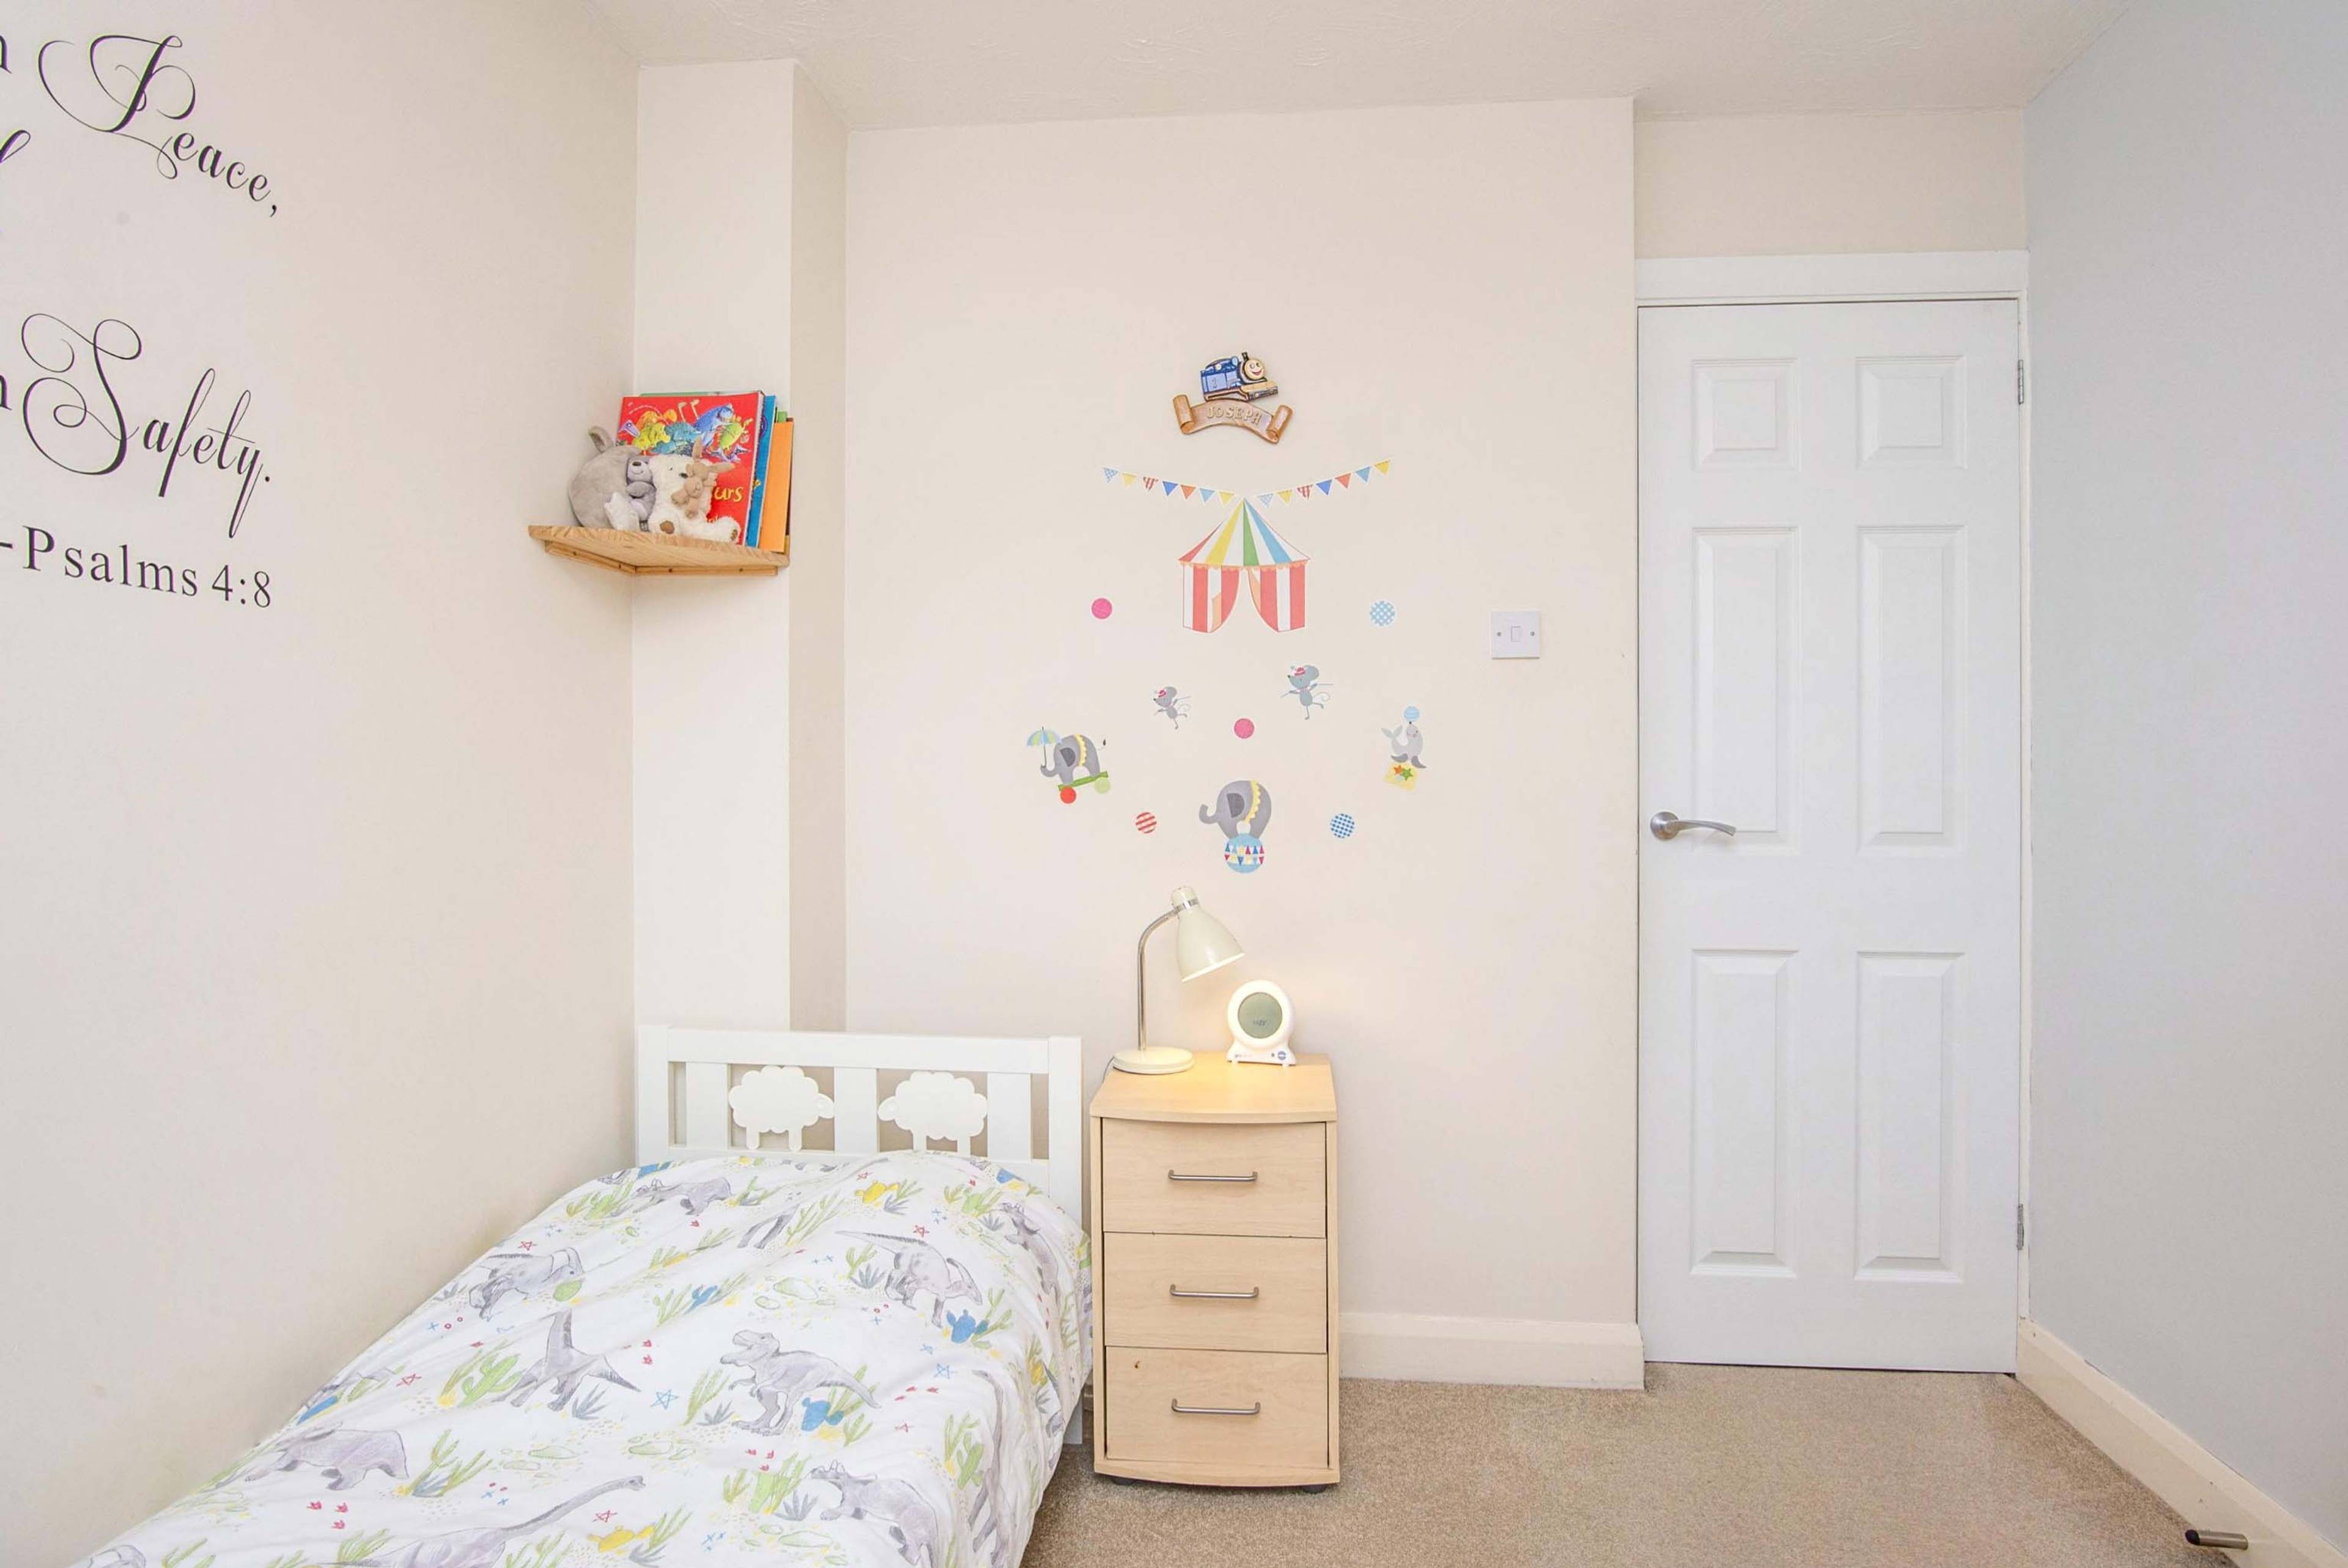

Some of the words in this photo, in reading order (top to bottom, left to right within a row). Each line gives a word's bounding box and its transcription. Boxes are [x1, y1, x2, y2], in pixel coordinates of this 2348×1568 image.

[38, 35, 277, 218] Peace,
[21, 314, 271, 539] Safety.
[1207, 406, 1261, 425] JOSEPH
[212, 565, 270, 608] 4:8
